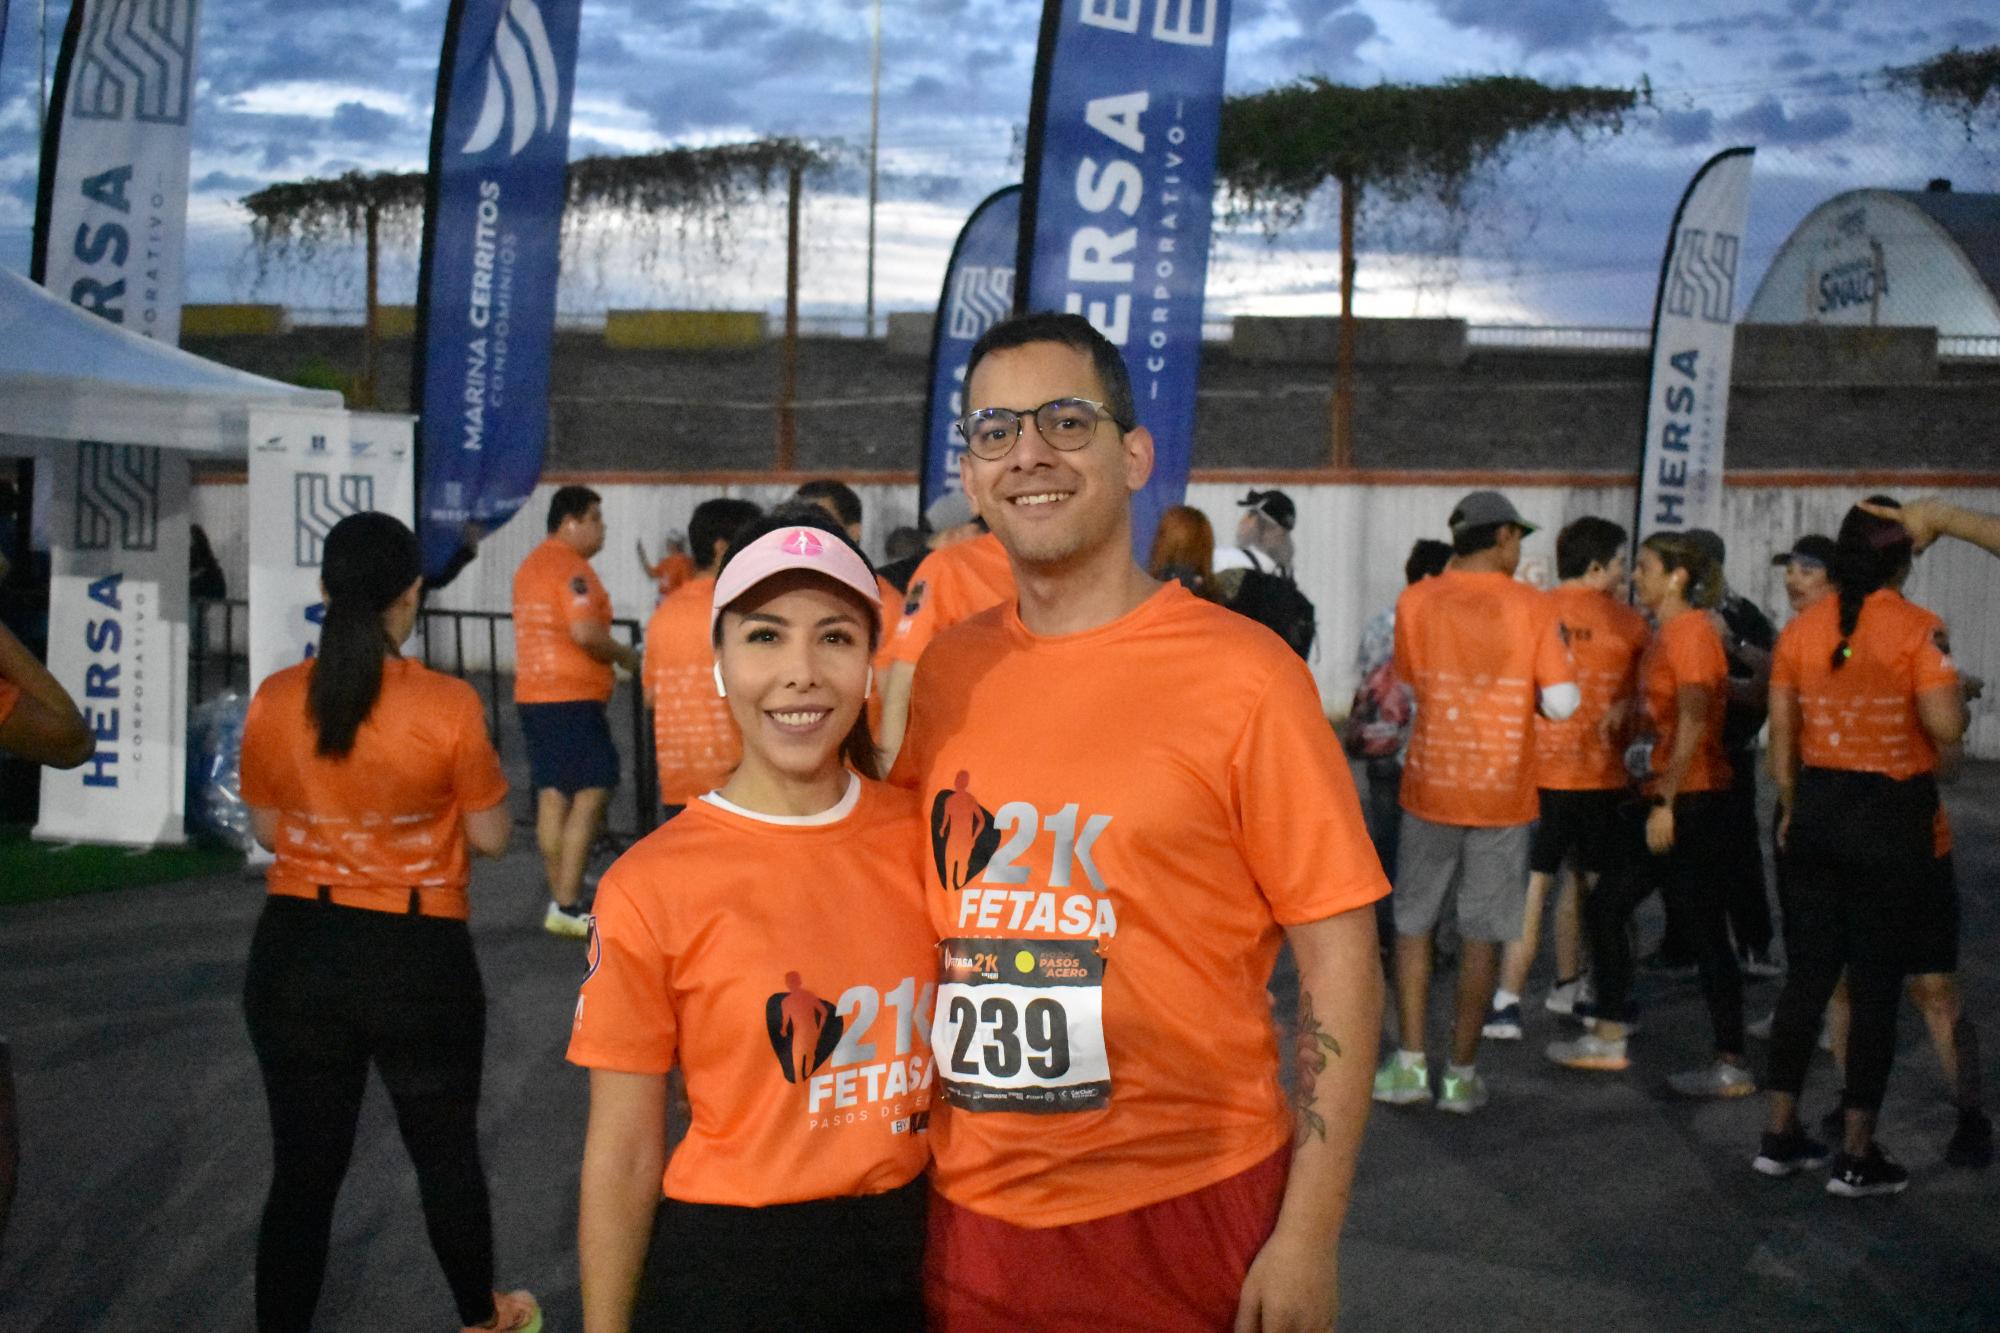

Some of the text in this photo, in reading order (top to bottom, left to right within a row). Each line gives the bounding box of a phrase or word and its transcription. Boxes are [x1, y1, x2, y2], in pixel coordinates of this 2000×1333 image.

[1148, 126, 1185, 374] CORPORATIVO
[462, 180, 501, 451] MARINA CERRITOS
[490, 232, 518, 408] CONDOMINIOS
[1654, 350, 1700, 526] HERSA
[82, 572, 123, 789] HERSA
[981, 802, 1113, 891] 21K
[958, 888, 1117, 938] FETASA
[973, 953, 999, 972] 21K
[1039, 958, 1080, 968] PASOS
[1046, 968, 1088, 977] ACERO
[949, 996, 1070, 1079] 239
[809, 1110, 868, 1130] PASOS
[881, 1103, 901, 1118] DE
